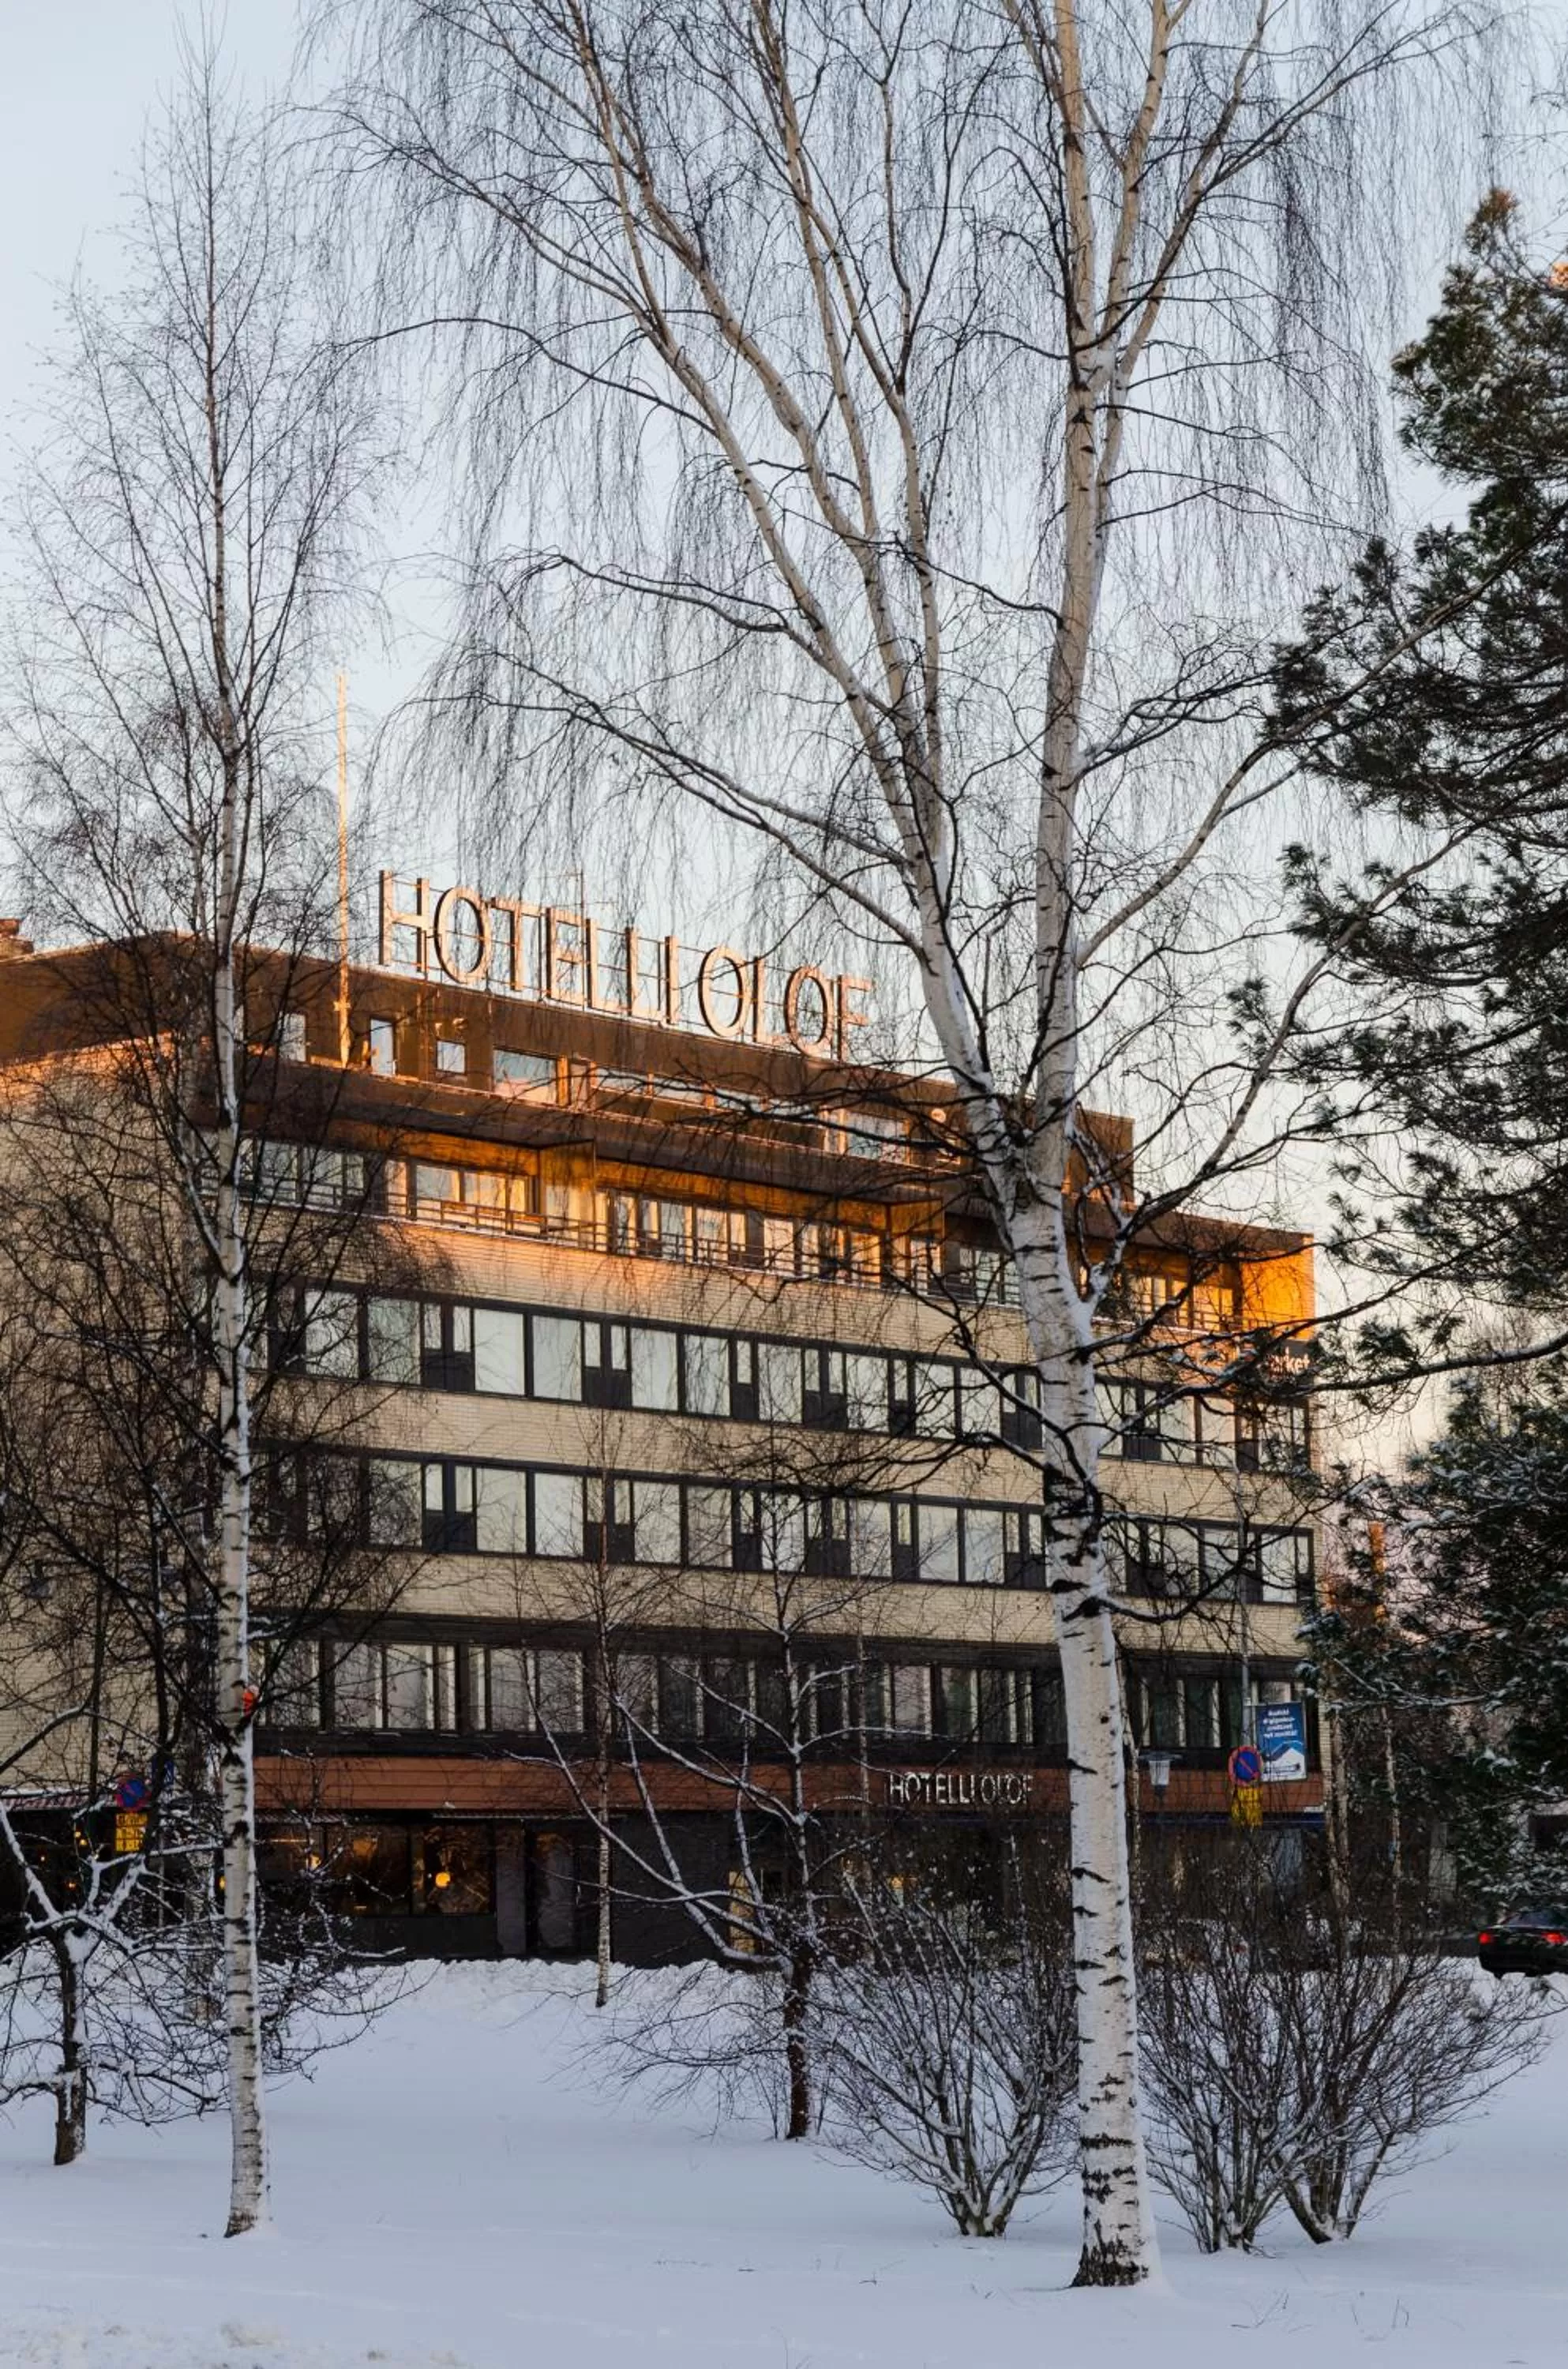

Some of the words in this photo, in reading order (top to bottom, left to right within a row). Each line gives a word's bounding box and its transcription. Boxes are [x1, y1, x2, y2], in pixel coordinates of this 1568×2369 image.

[379, 869, 679, 1025] HOTELLI
[698, 943, 874, 1062] OLOF
[889, 1771, 976, 1804] HOTELLI
[981, 1773, 1033, 1804] OLOF
